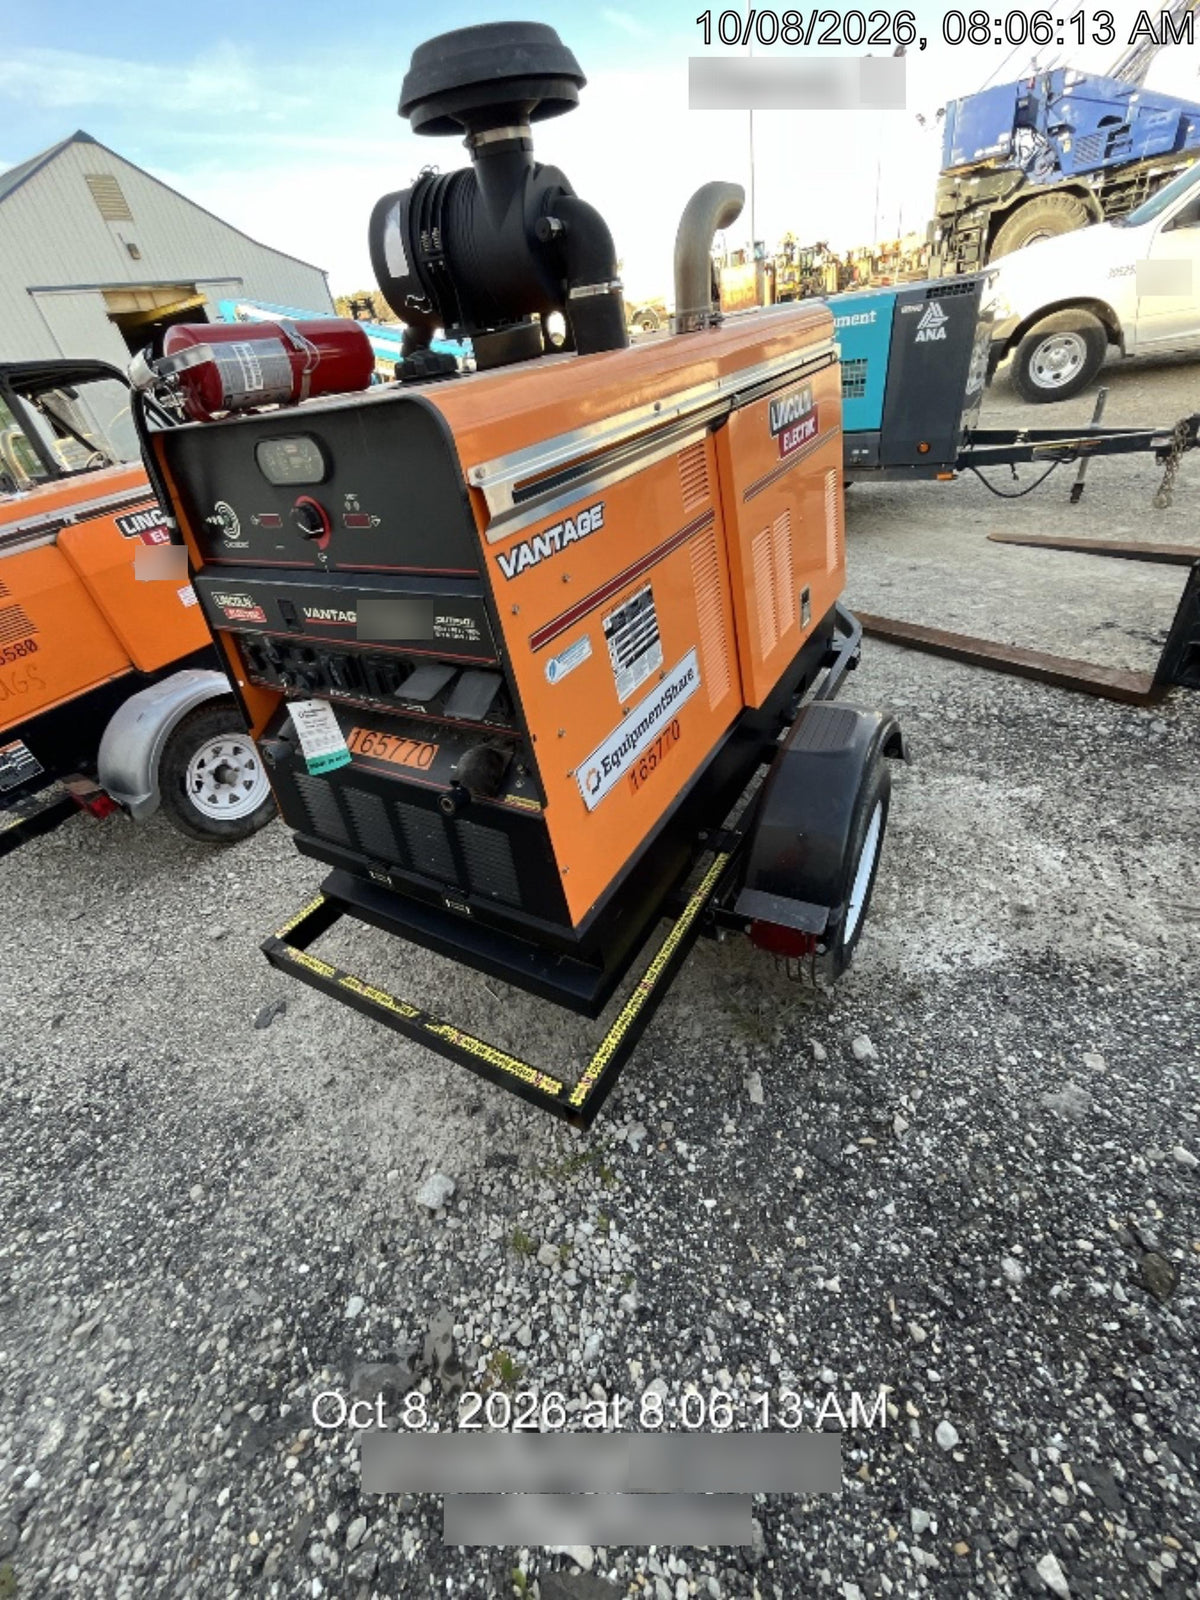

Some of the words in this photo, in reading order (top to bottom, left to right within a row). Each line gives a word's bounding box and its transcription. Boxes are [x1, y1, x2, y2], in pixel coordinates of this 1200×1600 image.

[915, 327, 946, 342] ANA
[119, 510, 165, 535] LINC
[496, 502, 604, 580] VANTAGE
[303, 607, 357, 623] VANTAG
[600, 667, 694, 778] EquipmentShare
[350, 729, 435, 767] 165770
[630, 719, 680, 791] 165770
